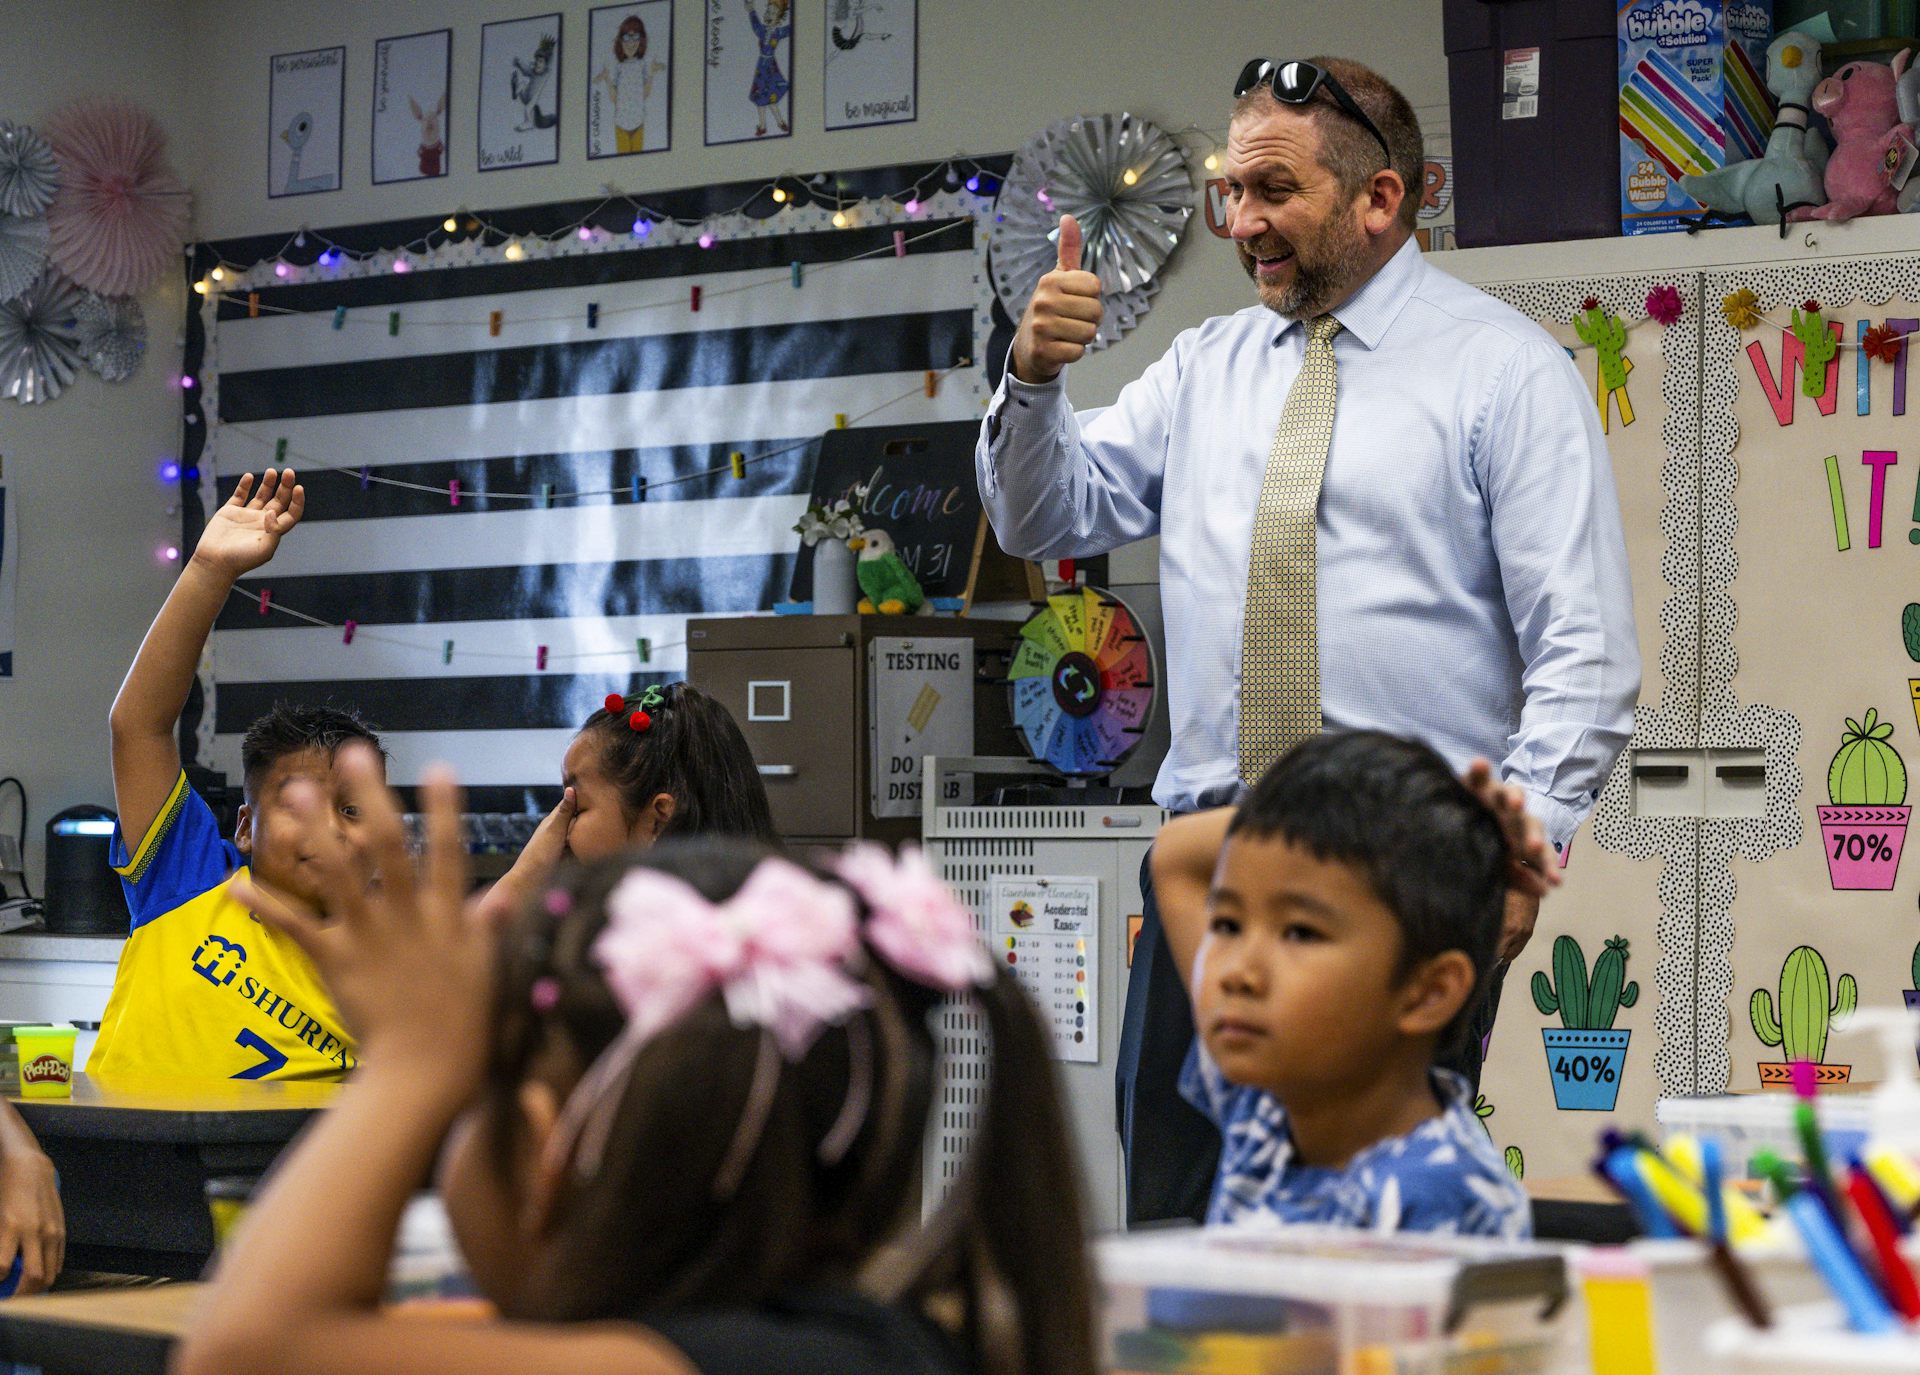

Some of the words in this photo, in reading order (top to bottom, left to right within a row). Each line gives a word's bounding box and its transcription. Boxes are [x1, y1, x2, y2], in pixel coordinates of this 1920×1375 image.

[1633, 11, 1650, 20] The
[1628, 10, 1705, 40] bubble
[1665, 33, 1707, 46] Solution
[1686, 58, 1713, 66] SUPER
[1691, 74, 1712, 82] Pack!
[845, 101, 861, 119] be
[862, 95, 911, 119] magical
[1638, 161, 1655, 175] 24
[1630, 175, 1667, 188] Bubble
[1629, 188, 1666, 201] Wands
[816, 465, 965, 521] lcome
[927, 543, 953, 577] 31
[886, 653, 960, 671] TESTING
[891, 756, 913, 774] DO
[888, 781, 960, 800] DISTB
[1832, 833, 1893, 863] 70%
[228, 1027, 289, 1080] 7
[23, 1060, 70, 1081] Play-Doh
[1554, 1055, 1616, 1084] 40%
